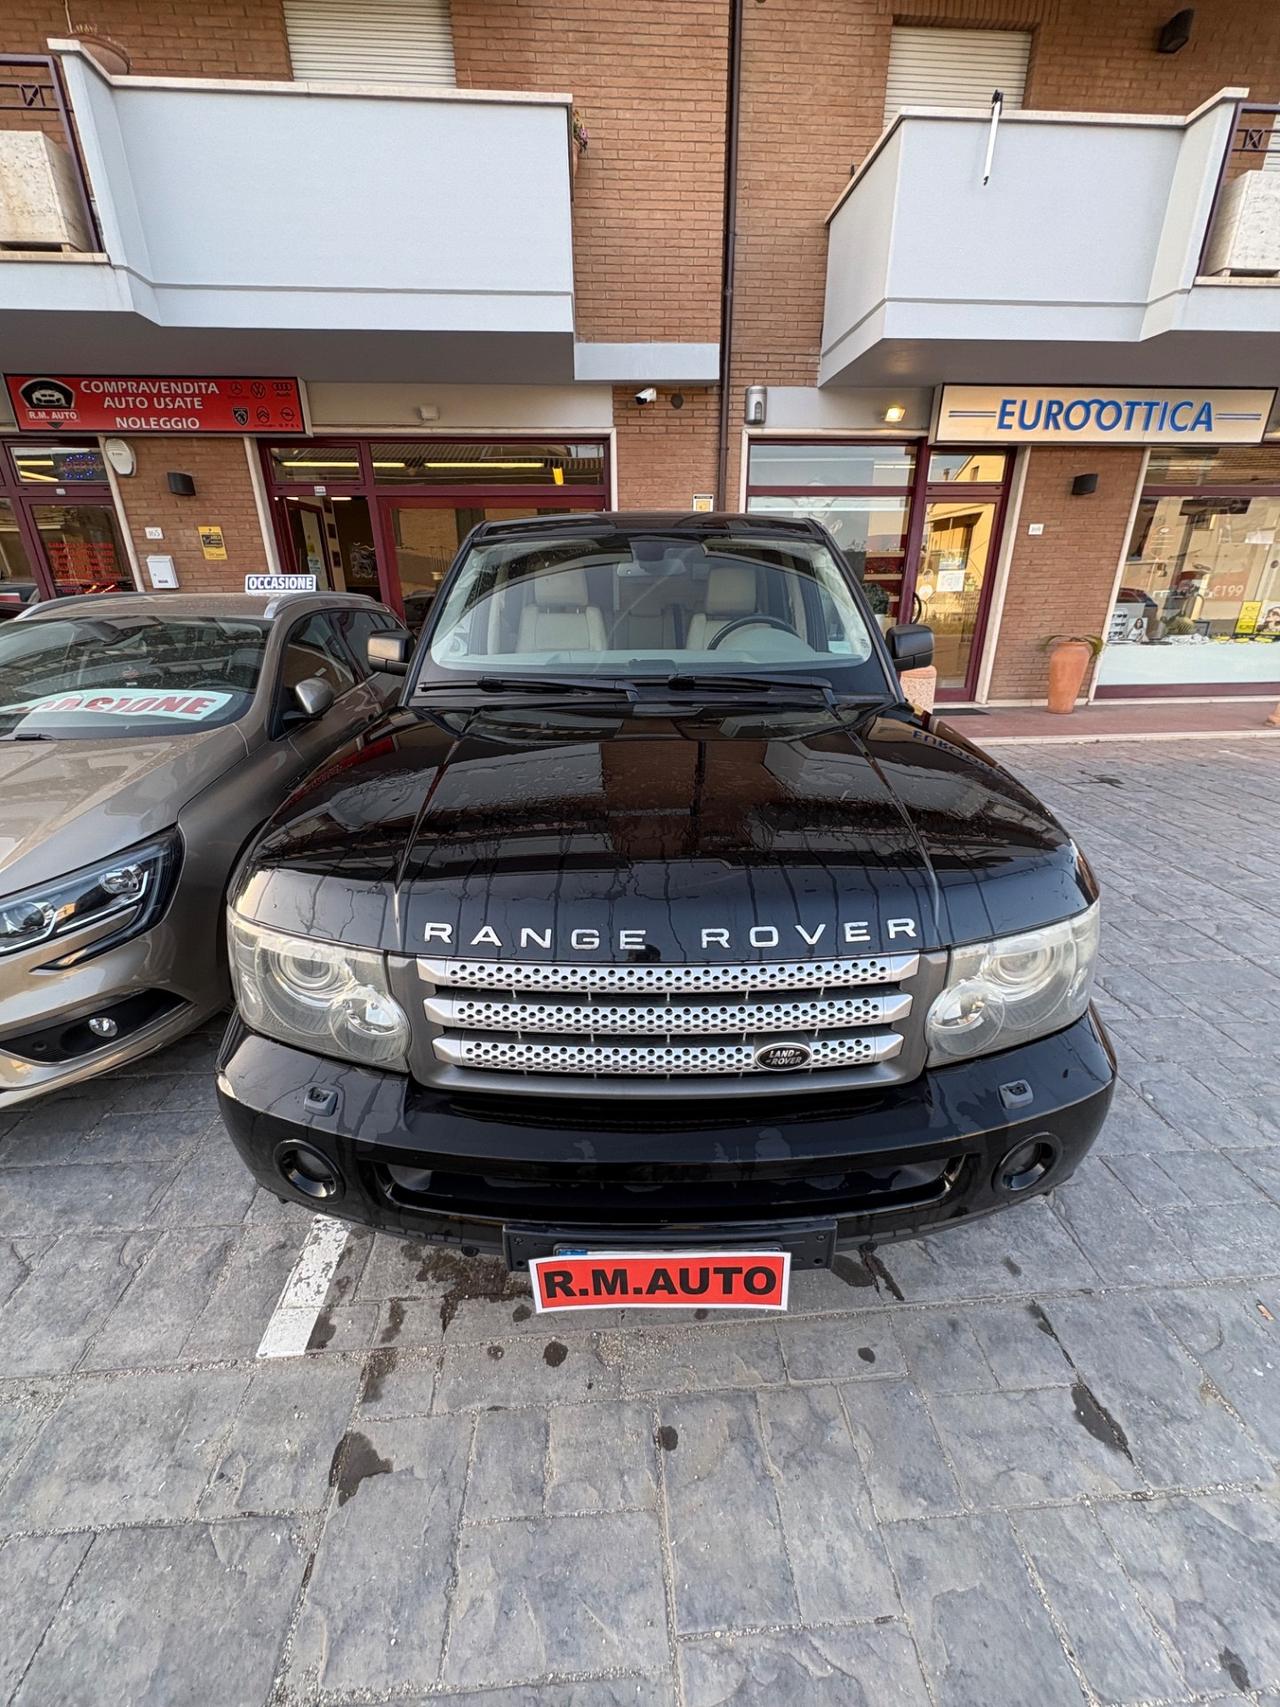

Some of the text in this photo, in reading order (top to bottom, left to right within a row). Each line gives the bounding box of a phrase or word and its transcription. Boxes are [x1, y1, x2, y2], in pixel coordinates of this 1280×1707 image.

[80, 381, 219, 394] COMPRAVENDITA
[103, 397, 203, 409] AUTO USATE
[28, 411, 77, 420] R.M. AUTO
[997, 398, 1213, 432] EUROOTTICA
[115, 417, 200, 429] NOLEGGIO
[248, 577, 314, 590] OCCASIONE
[424, 918, 918, 950] RANGE ROVER
[769, 1049, 795, 1058] LAND
[771, 1056, 802, 1065] ROVER
[543, 1266, 777, 1299] R.M.AUTO
